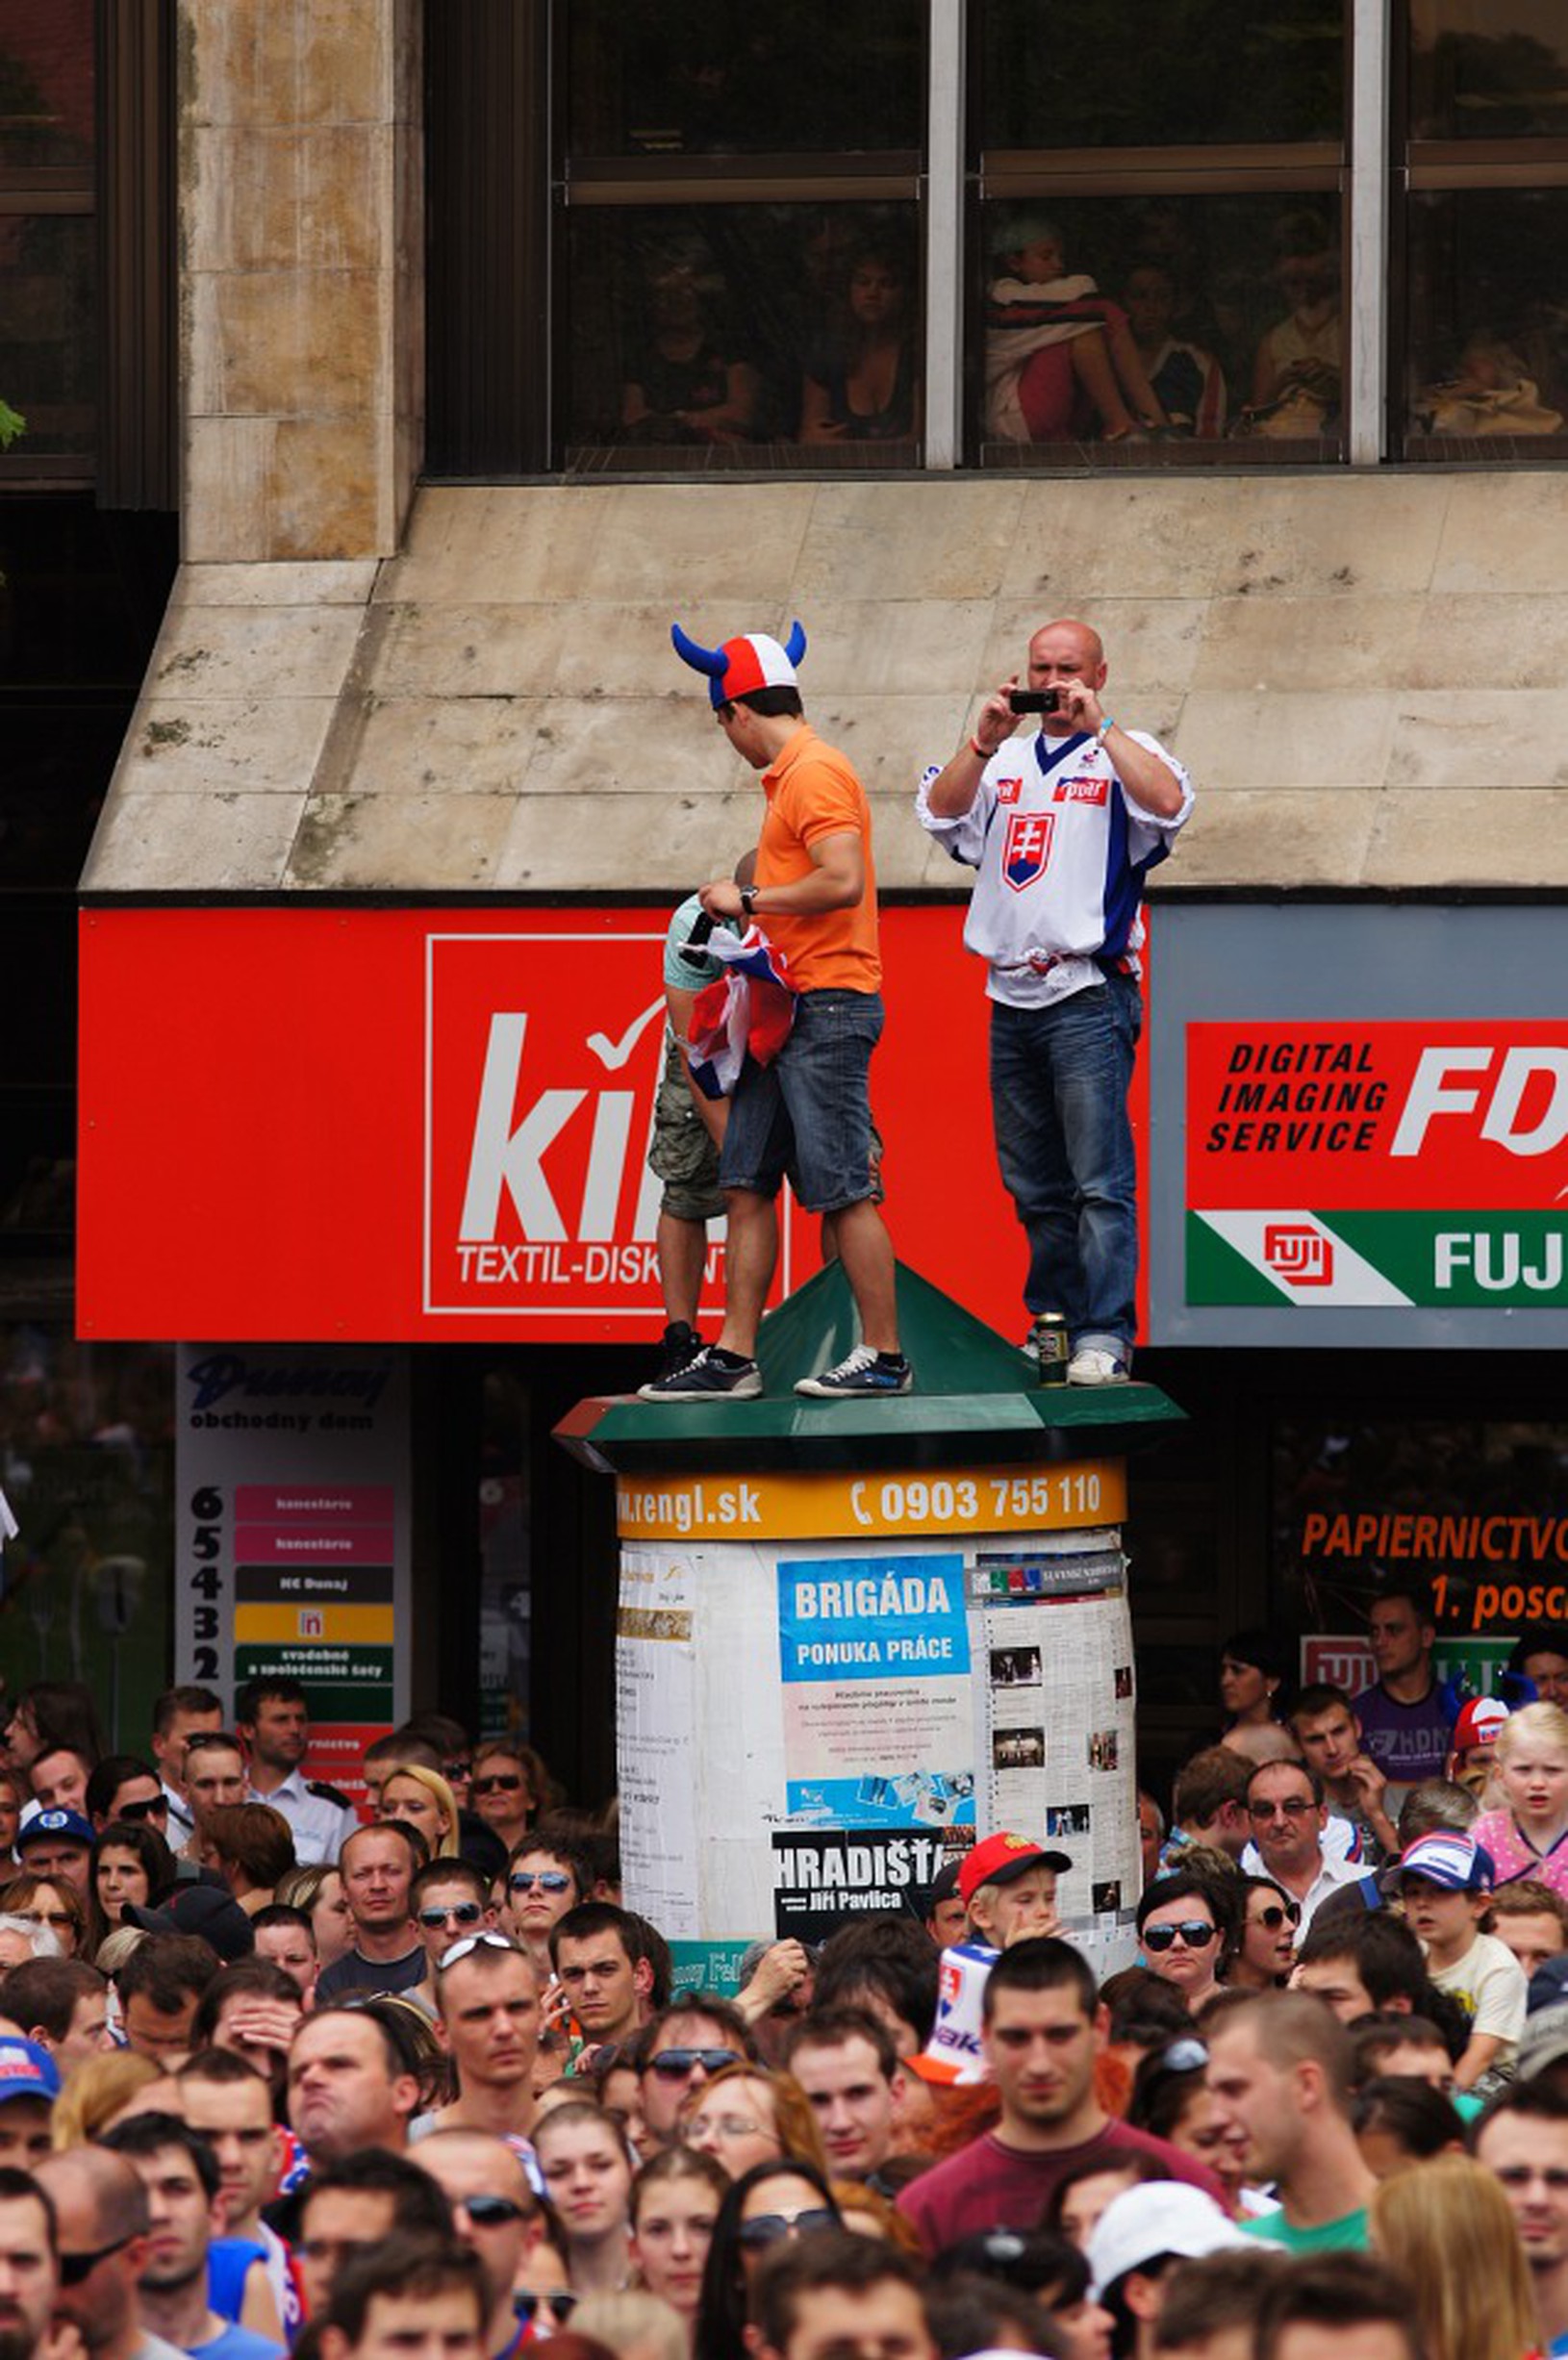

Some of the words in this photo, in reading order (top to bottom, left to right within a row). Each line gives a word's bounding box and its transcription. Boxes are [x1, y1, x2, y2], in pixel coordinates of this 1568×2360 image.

[1228, 1043, 1374, 1073] DIGITAL
[1218, 1082, 1388, 1112] IMAGING
[1206, 1122, 1378, 1152] SERVICE
[190, 1485, 223, 1520] 6
[880, 1481, 978, 1521] 0903
[989, 1478, 1048, 1516] 755
[1060, 1474, 1100, 1513] 110
[192, 1527, 221, 1560] 5
[190, 1567, 222, 1600] 4
[795, 1571, 951, 1619] BRIGÁDA
[1431, 1574, 1460, 1617] 1.
[1472, 1585, 1568, 1630] posc
[193, 1606, 219, 1639] 3
[193, 1646, 219, 1680] 2
[797, 1641, 881, 1665] PONUKA
[886, 1634, 952, 1662] PRÁCE
[839, 1889, 902, 1910] Pavlica
